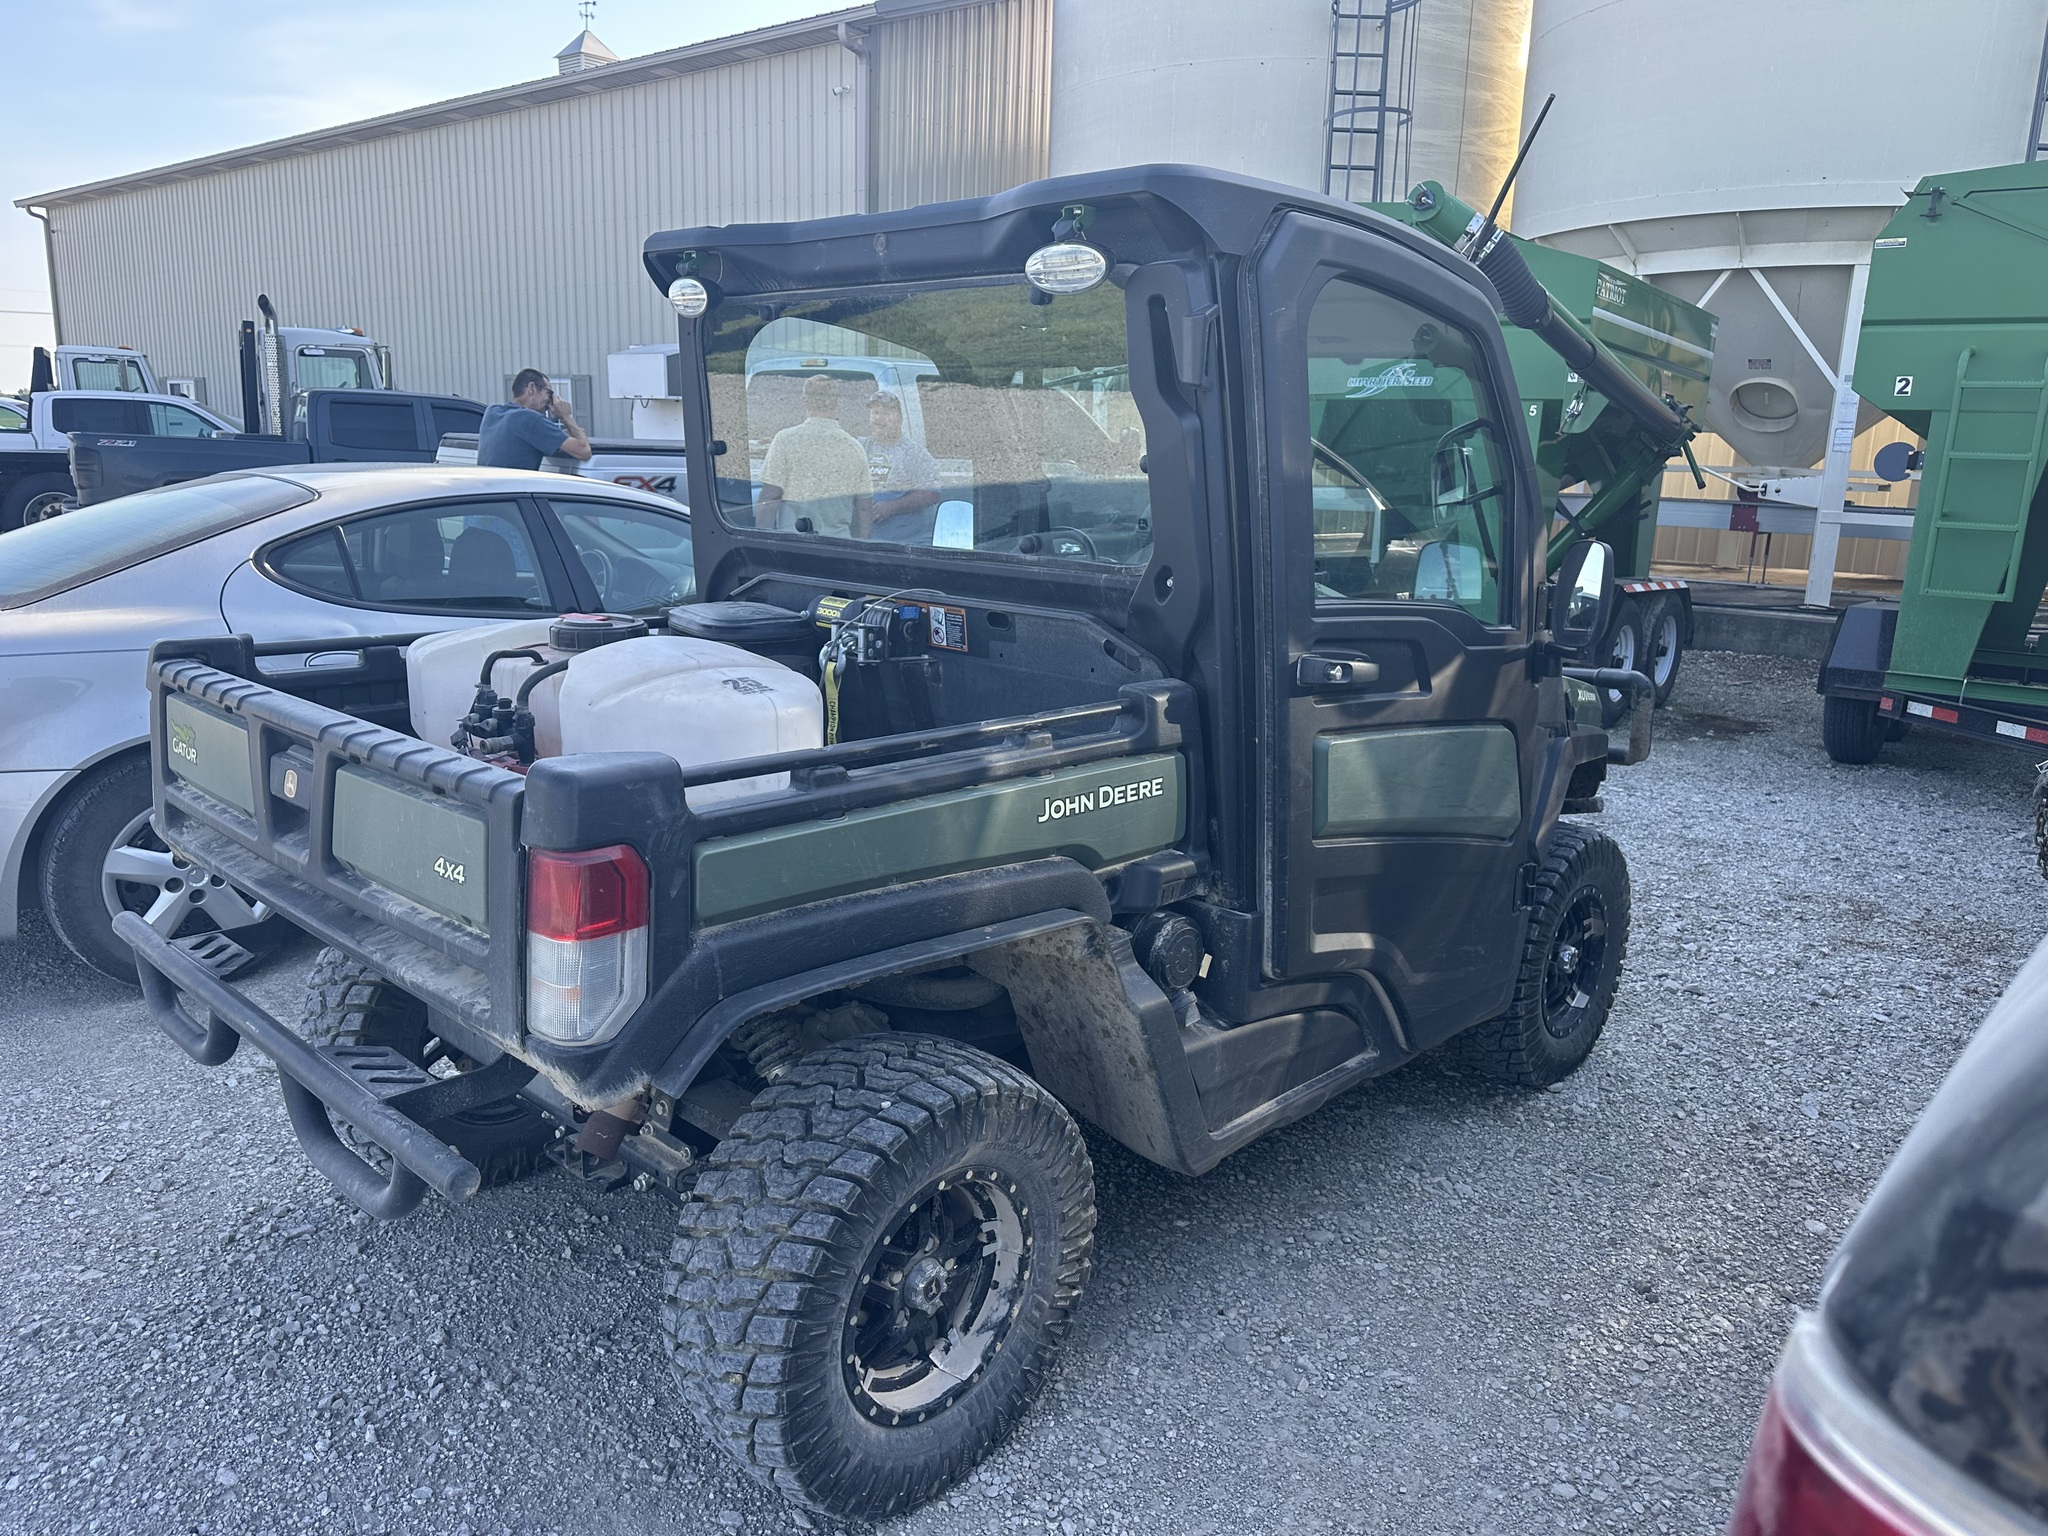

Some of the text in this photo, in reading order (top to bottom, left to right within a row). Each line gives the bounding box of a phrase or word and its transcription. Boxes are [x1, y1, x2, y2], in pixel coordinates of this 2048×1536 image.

[1596, 278, 1627, 305] PATRIOT
[1403, 376, 1434, 387] SEED
[1896, 377, 1911, 395] 2
[1528, 404, 1538, 417] 5
[613, 475, 677, 493] FX4
[828, 701, 837, 733] CHAMPION
[172, 736, 198, 765] GATOR
[1037, 776, 1164, 824] JOHN DEERE
